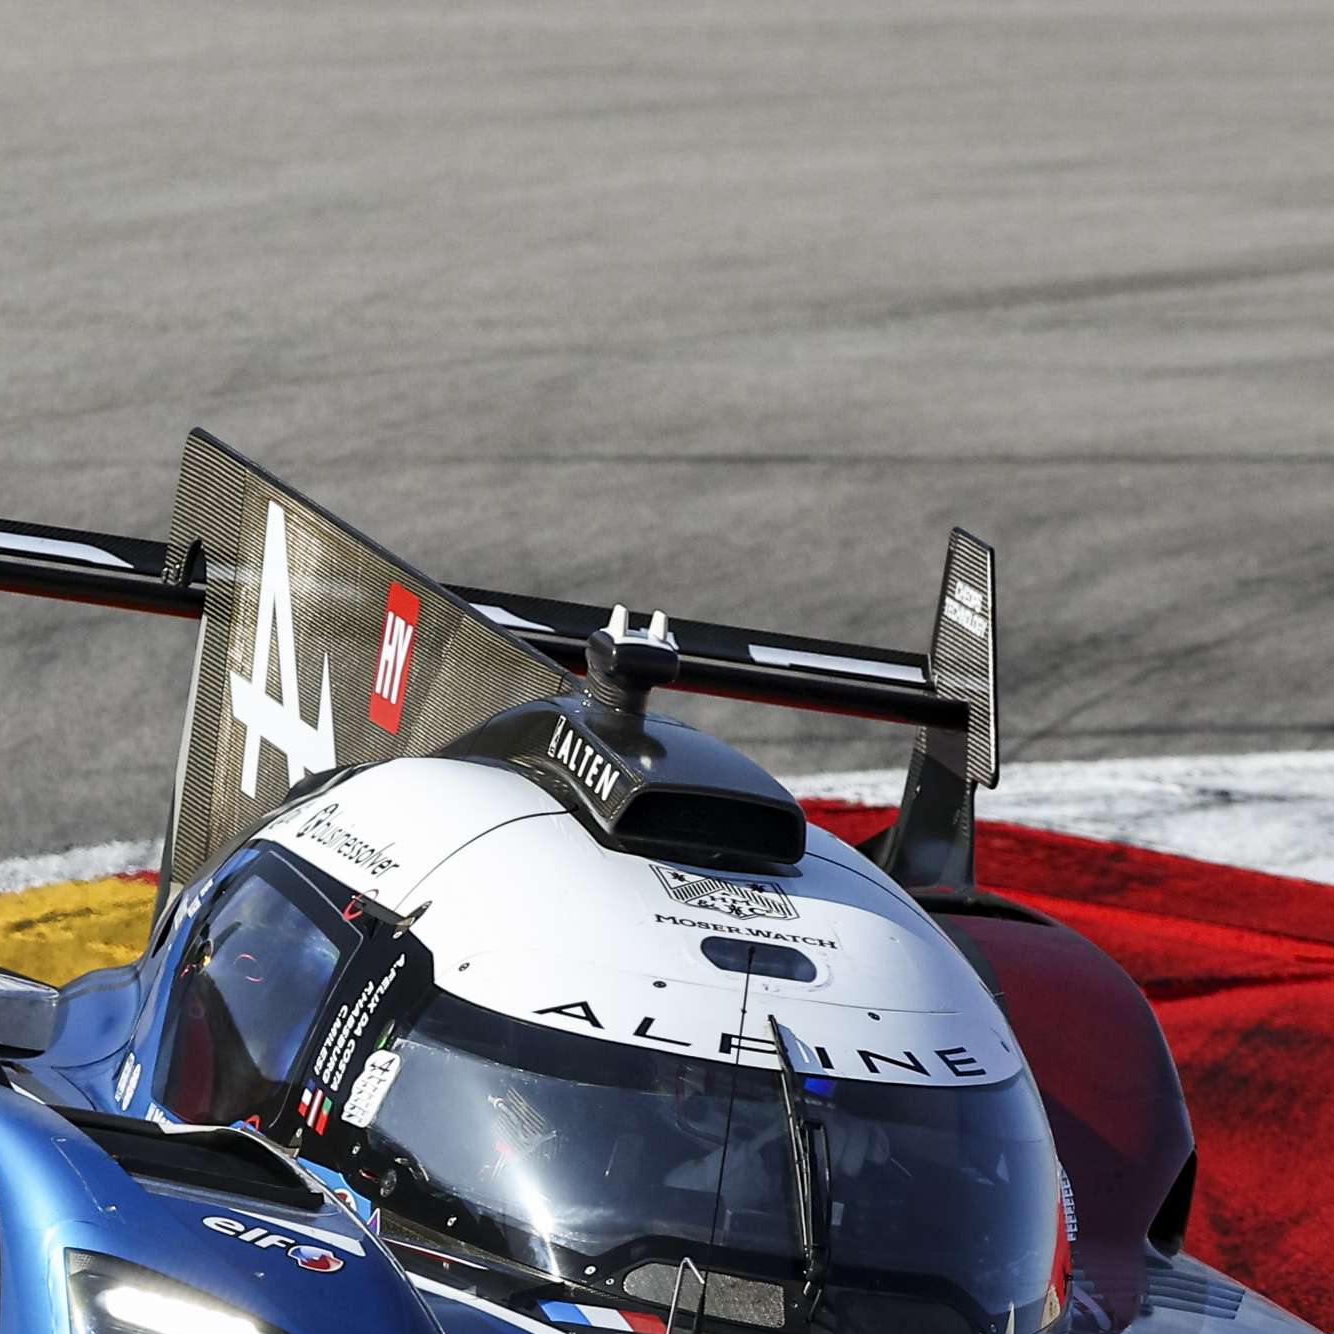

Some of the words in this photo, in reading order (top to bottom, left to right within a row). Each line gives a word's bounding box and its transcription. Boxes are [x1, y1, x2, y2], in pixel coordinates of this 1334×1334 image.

[374, 610, 414, 705] HY
[557, 729, 621, 802] ALTEN
[310, 810, 401, 880] businessolver
[654, 913, 839, 950] MOSER.WATCH
[313, 1004, 349, 1076] C.MILESI
[353, 1012, 370, 1037] DA
[533, 1001, 987, 1077] ALPINE
[329, 1038, 356, 1092] COSTA
[202, 1216, 296, 1249] elf
